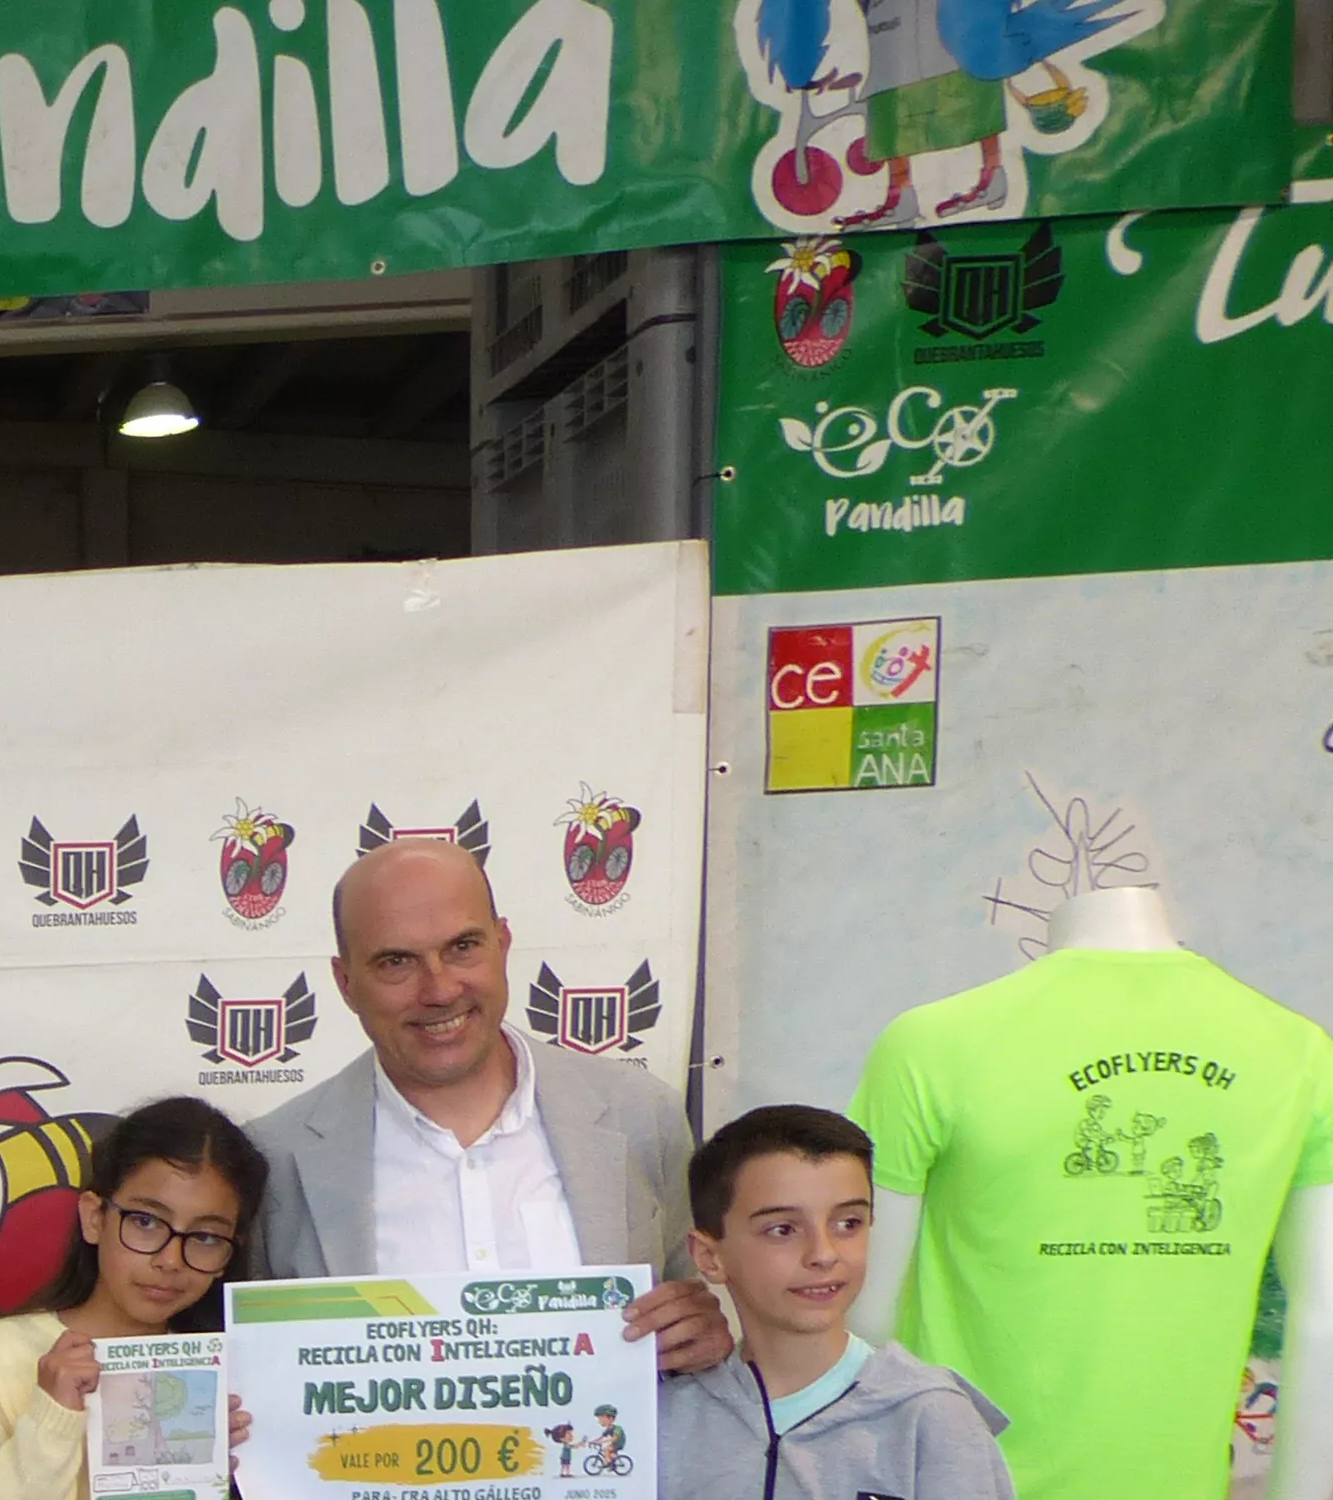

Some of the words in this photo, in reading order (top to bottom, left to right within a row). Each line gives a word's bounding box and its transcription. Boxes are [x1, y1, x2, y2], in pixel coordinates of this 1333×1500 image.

[914, 340, 1046, 365] QUEBRANTAHUESOS
[824, 494, 966, 537] Pandilla
[771, 660, 843, 709] ce
[857, 723, 925, 749] santa
[856, 752, 931, 788] ANA
[31, 910, 139, 929] QUEBRANTAHUESOS
[197, 1067, 305, 1087] QUEBRANTAHUESOS
[1068, 1051, 1199, 1092] ECOFLYERS
[1201, 1061, 1238, 1090] QH
[1039, 1242, 1097, 1256] RECICLA
[1099, 1242, 1128, 1256] CON
[1132, 1242, 1231, 1256] INTELIGENCIA
[365, 1319, 463, 1340] ECOFLYERS
[465, 1318, 499, 1340] QH:
[107, 1343, 180, 1360] ECOFLYERS
[183, 1341, 202, 1357] QH
[297, 1345, 379, 1366] RECICLA
[382, 1343, 422, 1363] CON
[302, 1377, 428, 1416] MEJOR
[433, 1363, 574, 1411] DISEÑO
[339, 1453, 370, 1469] VALE
[374, 1451, 400, 1468] POR
[414, 1436, 482, 1477] 200
